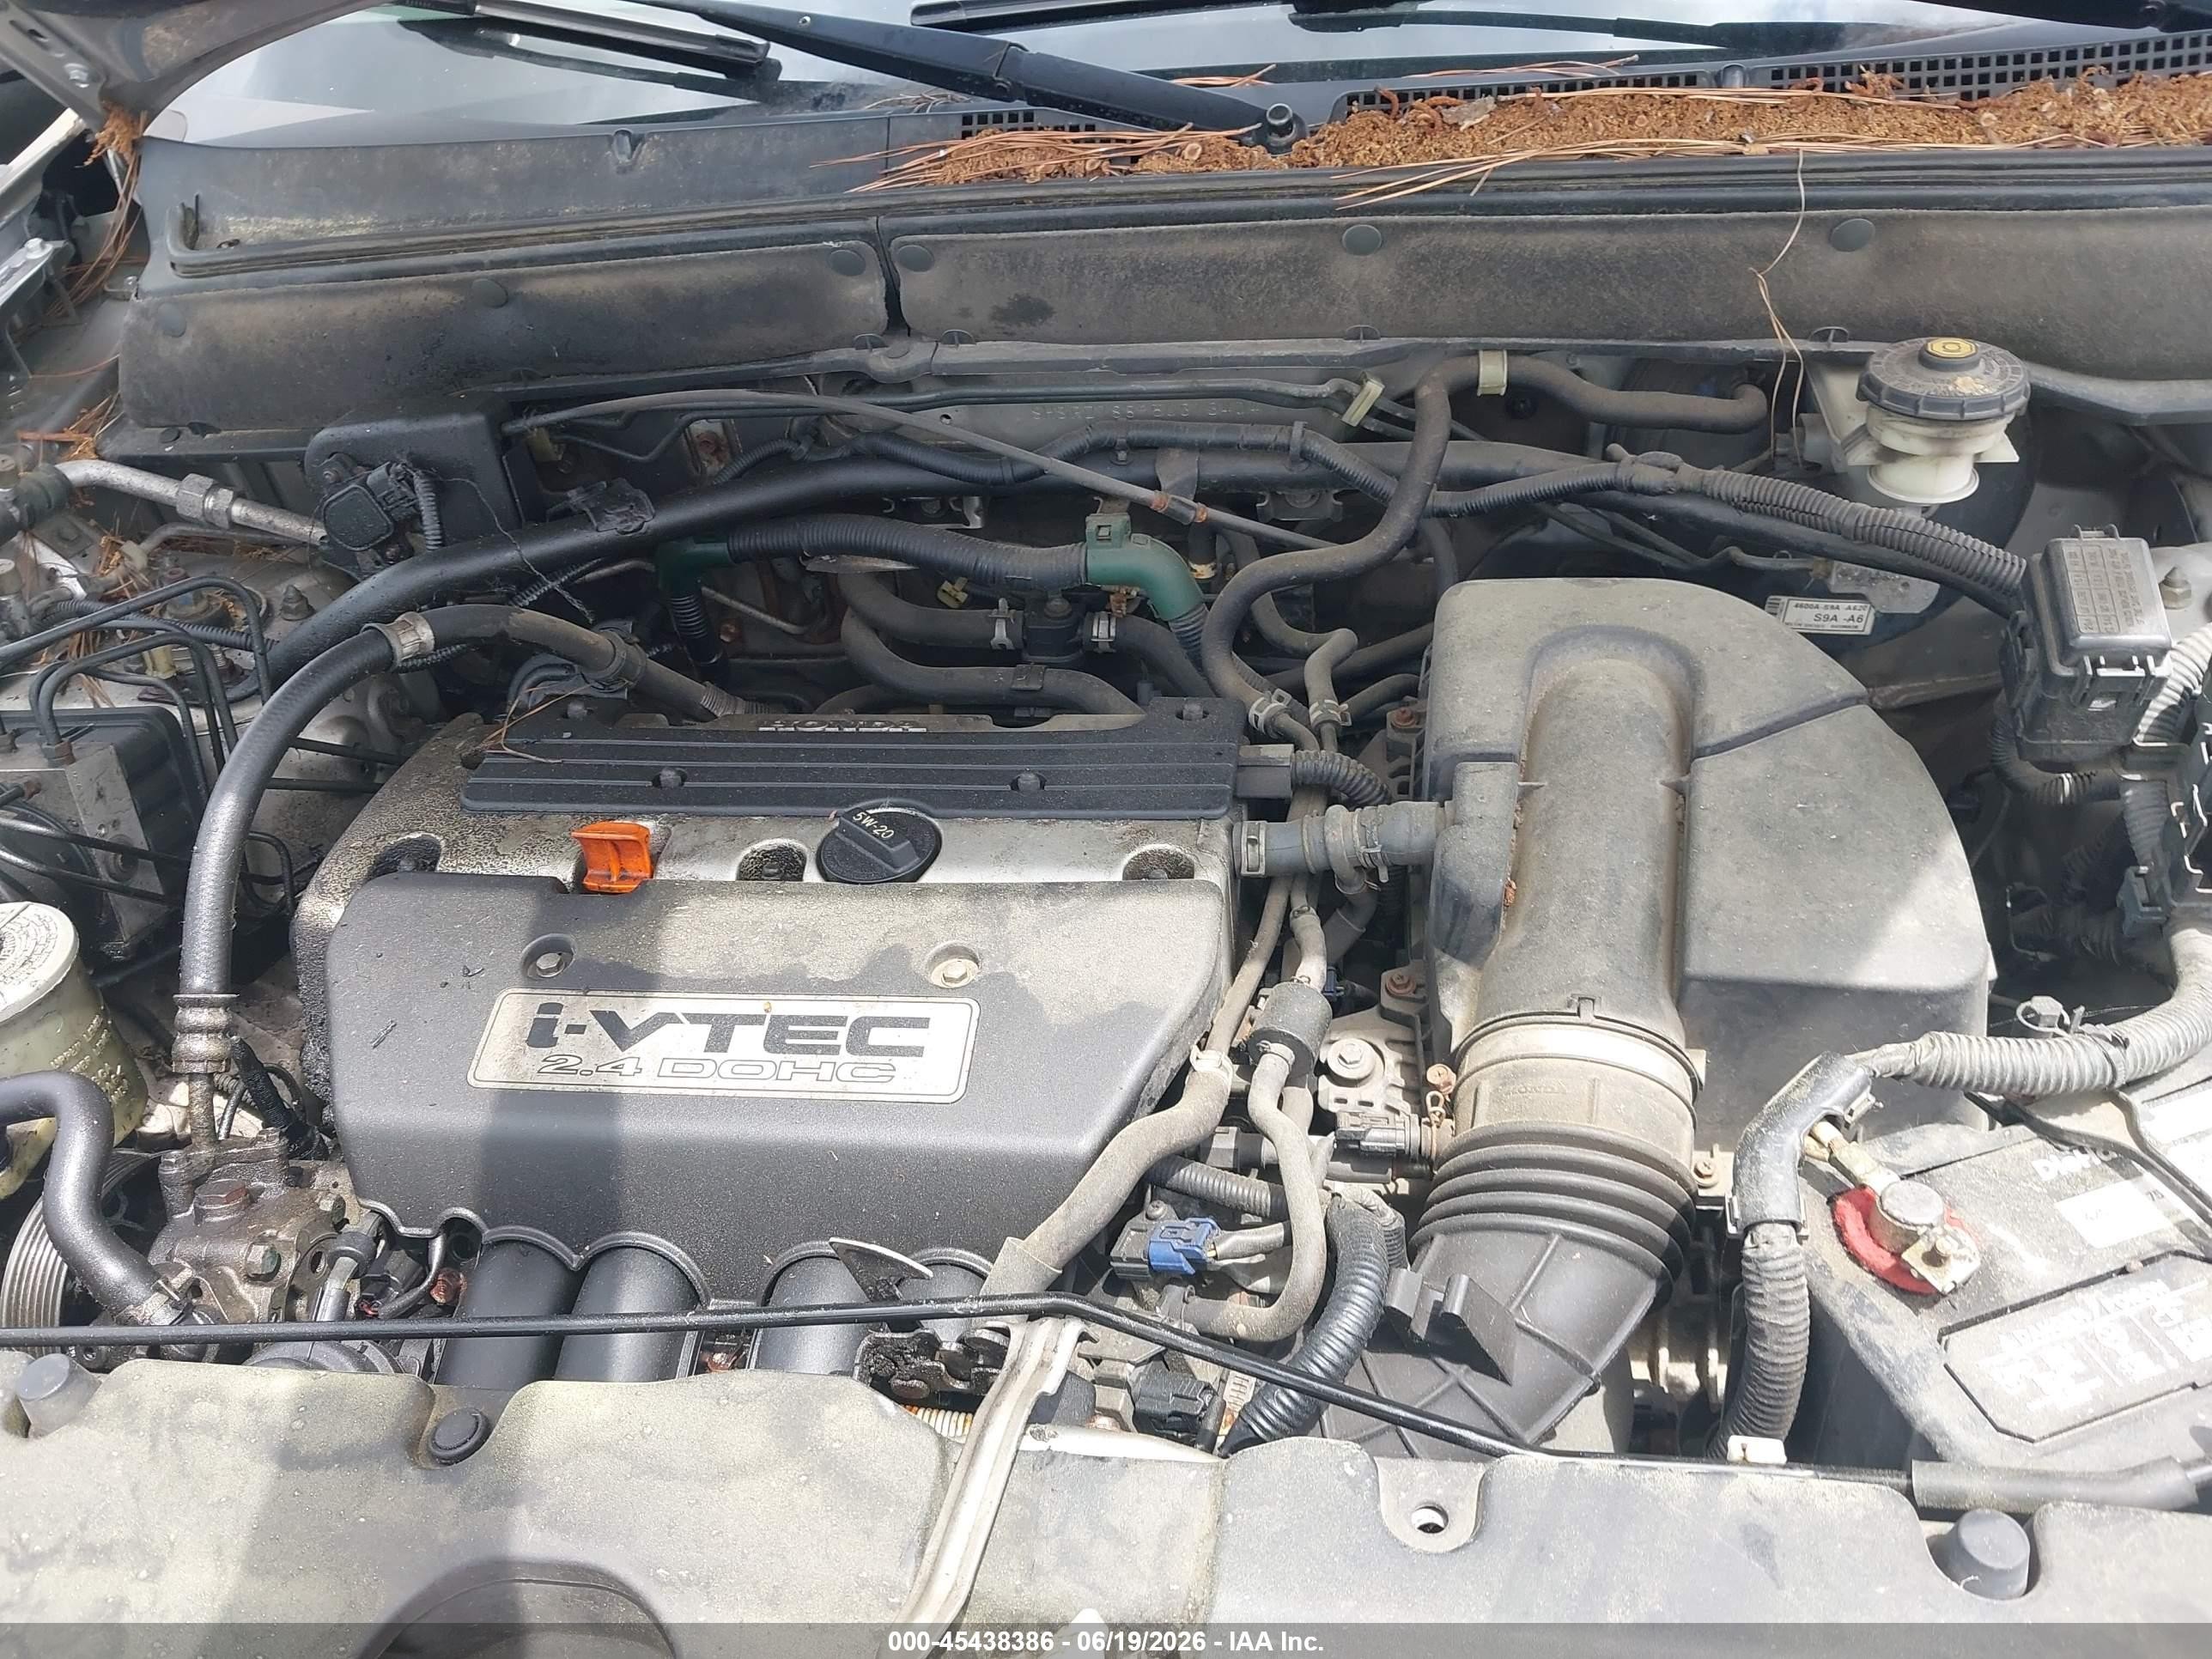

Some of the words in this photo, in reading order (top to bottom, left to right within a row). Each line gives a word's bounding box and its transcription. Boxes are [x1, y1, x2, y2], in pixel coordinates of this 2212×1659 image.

[1814, 613, 1838, 623] S9A
[852, 811, 896, 839] 5W-20
[525, 1001, 931, 1058] i-VTEC
[537, 1054, 642, 1079] 2.4
[658, 1057, 897, 1084] DOHC
